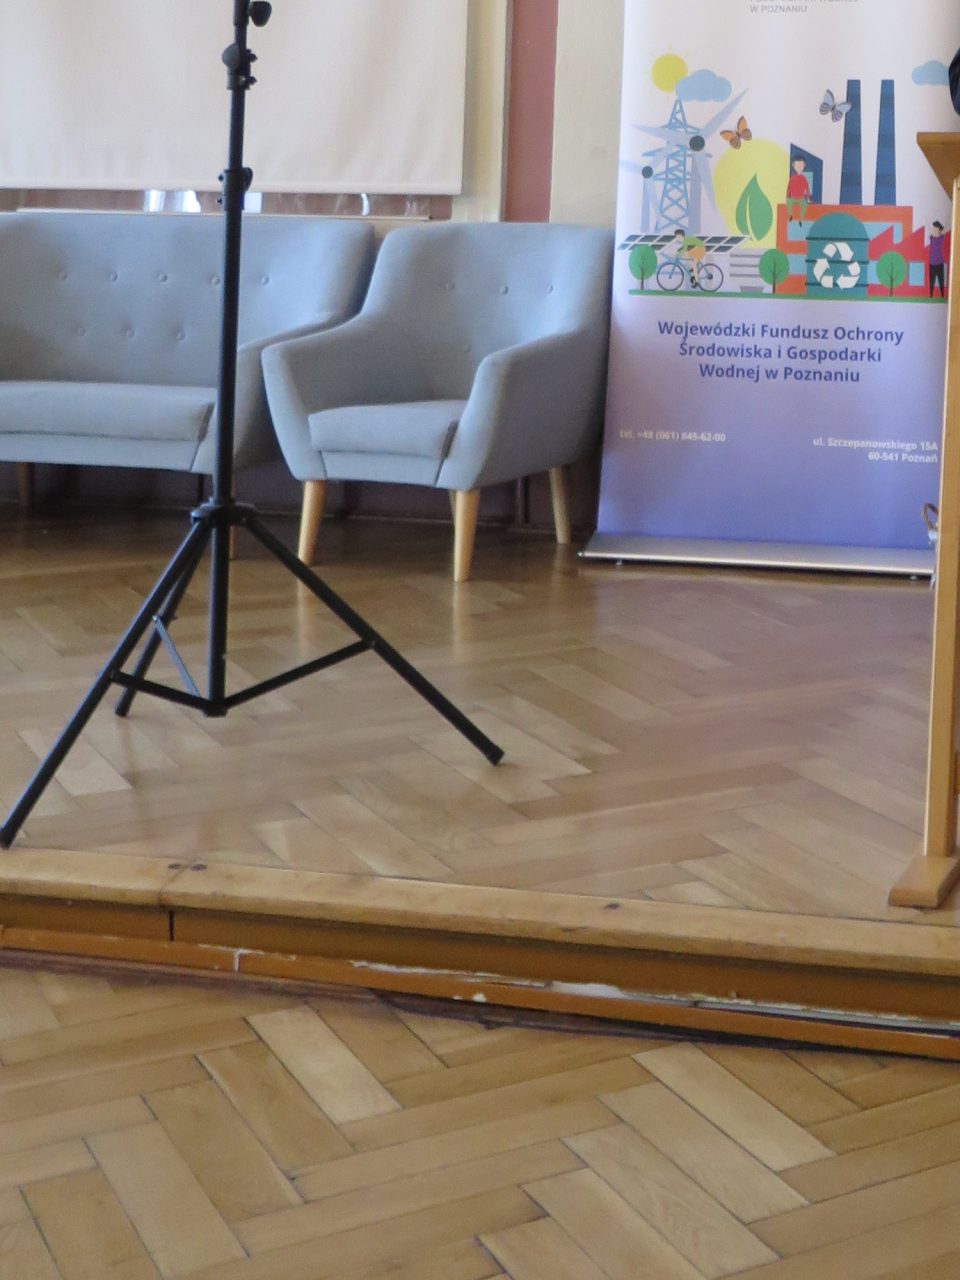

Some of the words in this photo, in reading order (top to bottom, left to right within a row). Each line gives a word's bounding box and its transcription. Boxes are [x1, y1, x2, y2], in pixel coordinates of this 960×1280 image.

[750, 4, 758, 13] W
[761, 4, 808, 13] POZNANIU
[658, 321, 756, 340] Wojewódzki
[760, 325, 829, 340] Fundusz
[834, 326, 904, 345] Ochrony
[679, 338, 772, 358] Środowiska
[777, 345, 782, 358] i
[787, 346, 881, 363] Gospodarki
[699, 364, 760, 383] Wodnej
[765, 369, 778, 380] w
[783, 367, 861, 382] Poznaniu
[813, 436, 826, 446] ul.
[828, 438, 918, 452] Szczepanowskiego
[902, 452, 938, 463] Poznań
